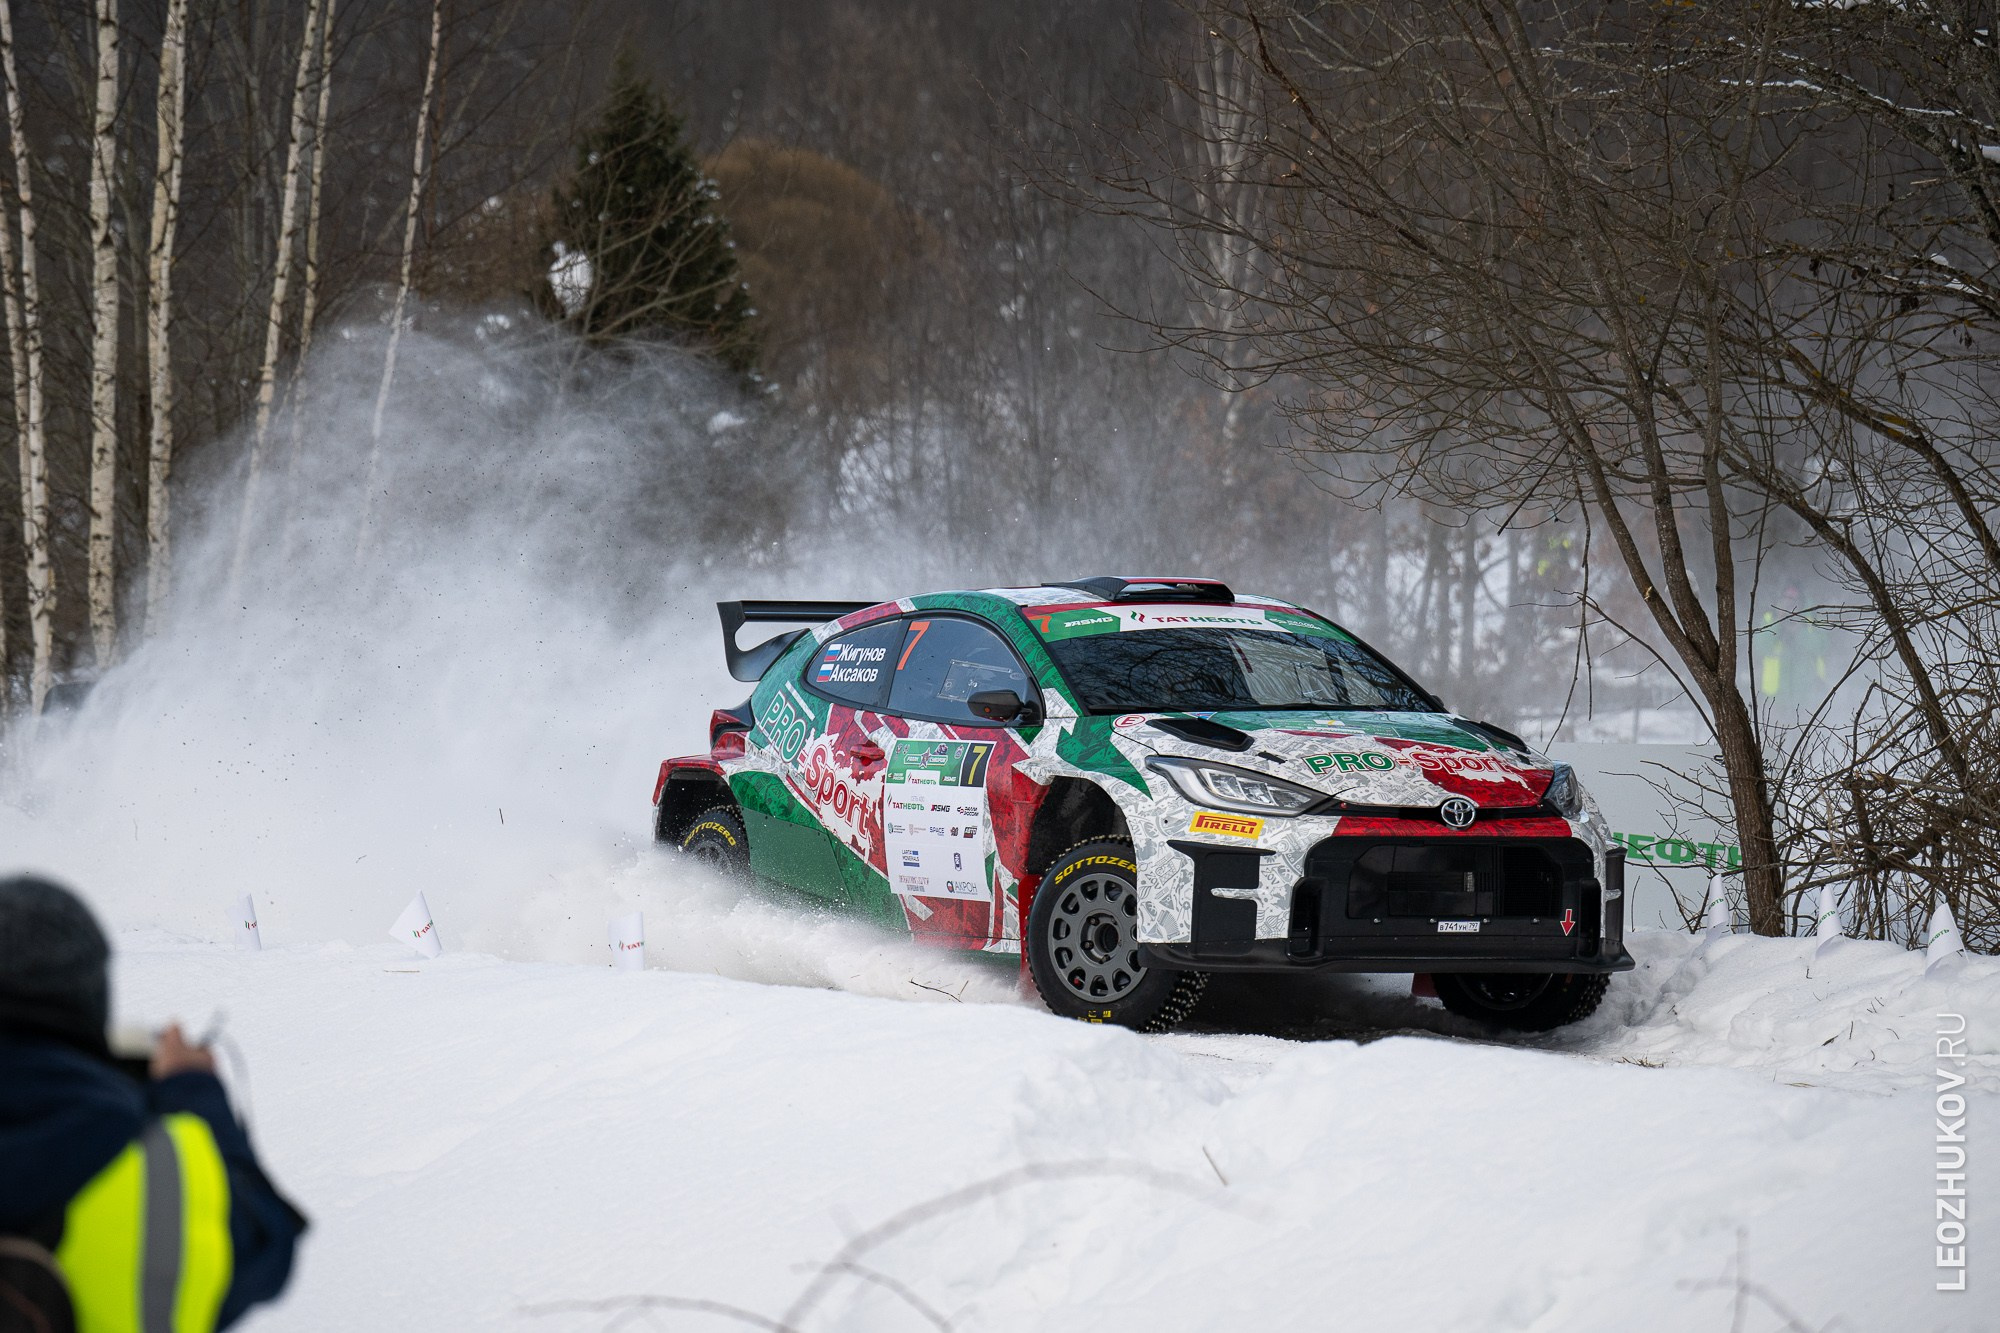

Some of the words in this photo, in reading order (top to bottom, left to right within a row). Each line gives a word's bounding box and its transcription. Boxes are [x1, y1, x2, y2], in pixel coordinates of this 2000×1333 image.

[1028, 615, 1052, 633] 7
[1152, 616, 1262, 625] ТАТНЕФТЬ
[836, 644, 887, 666] Жигунов
[896, 621, 931, 671] 7
[828, 664, 879, 682] Аксаков
[1120, 716, 1139, 725] E
[968, 745, 988, 785] 7
[892, 802, 925, 811] ТАТНЕФТЬ
[1195, 814, 1258, 834] PIRELLI
[1055, 855, 1137, 885] SOTTOZER
[955, 881, 978, 893] АКРОН
